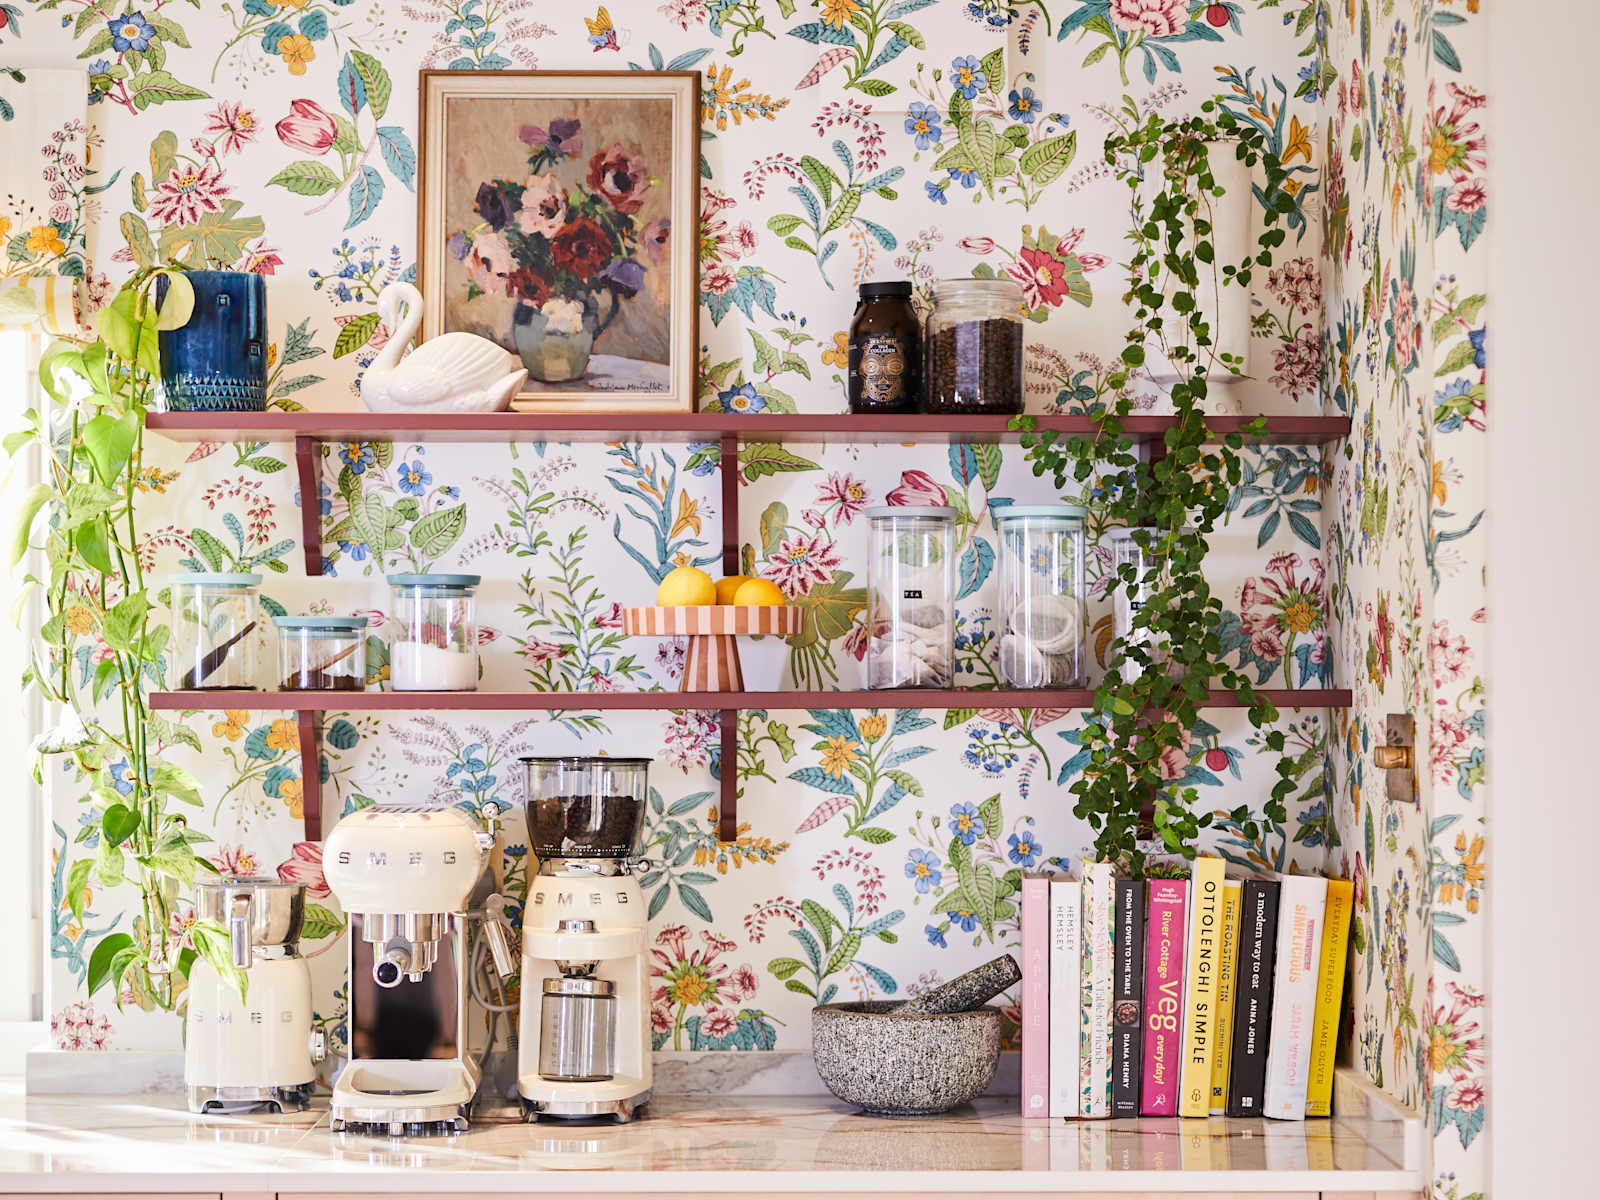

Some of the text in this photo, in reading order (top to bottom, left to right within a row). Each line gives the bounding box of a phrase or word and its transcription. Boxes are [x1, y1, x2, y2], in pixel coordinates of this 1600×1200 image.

[338, 851, 456, 865] SMEG
[534, 891, 628, 905] SMEG
[1125, 888, 1133, 909] FROM
[1056, 905, 1064, 951] HEMSLEY
[1066, 905, 1075, 951] HEMSLEY
[1125, 910, 1133, 924] THE
[1161, 911, 1172, 938] River
[1255, 899, 1267, 938] modern
[1124, 925, 1132, 946] OVEN
[1289, 904, 1307, 984] SIMPLICIOUS
[1124, 946, 1132, 957] TO
[1157, 939, 1171, 979] Cottage
[1220, 900, 1235, 1002] THE ROASTING TIN
[1251, 939, 1262, 962] way
[1324, 897, 1343, 1004] EVERYDAY SUPER FOOD
[1192, 881, 1216, 1064] OTTOLENGHI SIMPLE
[1251, 973, 1260, 989] eat
[1252, 962, 1261, 973] to
[194, 1010, 293, 1024] SMEG
[1247, 998, 1258, 1055] ANNA JONES
[1316, 1019, 1329, 1085] JAMIE OLIVER
[1122, 1061, 1130, 1089] HENRY
